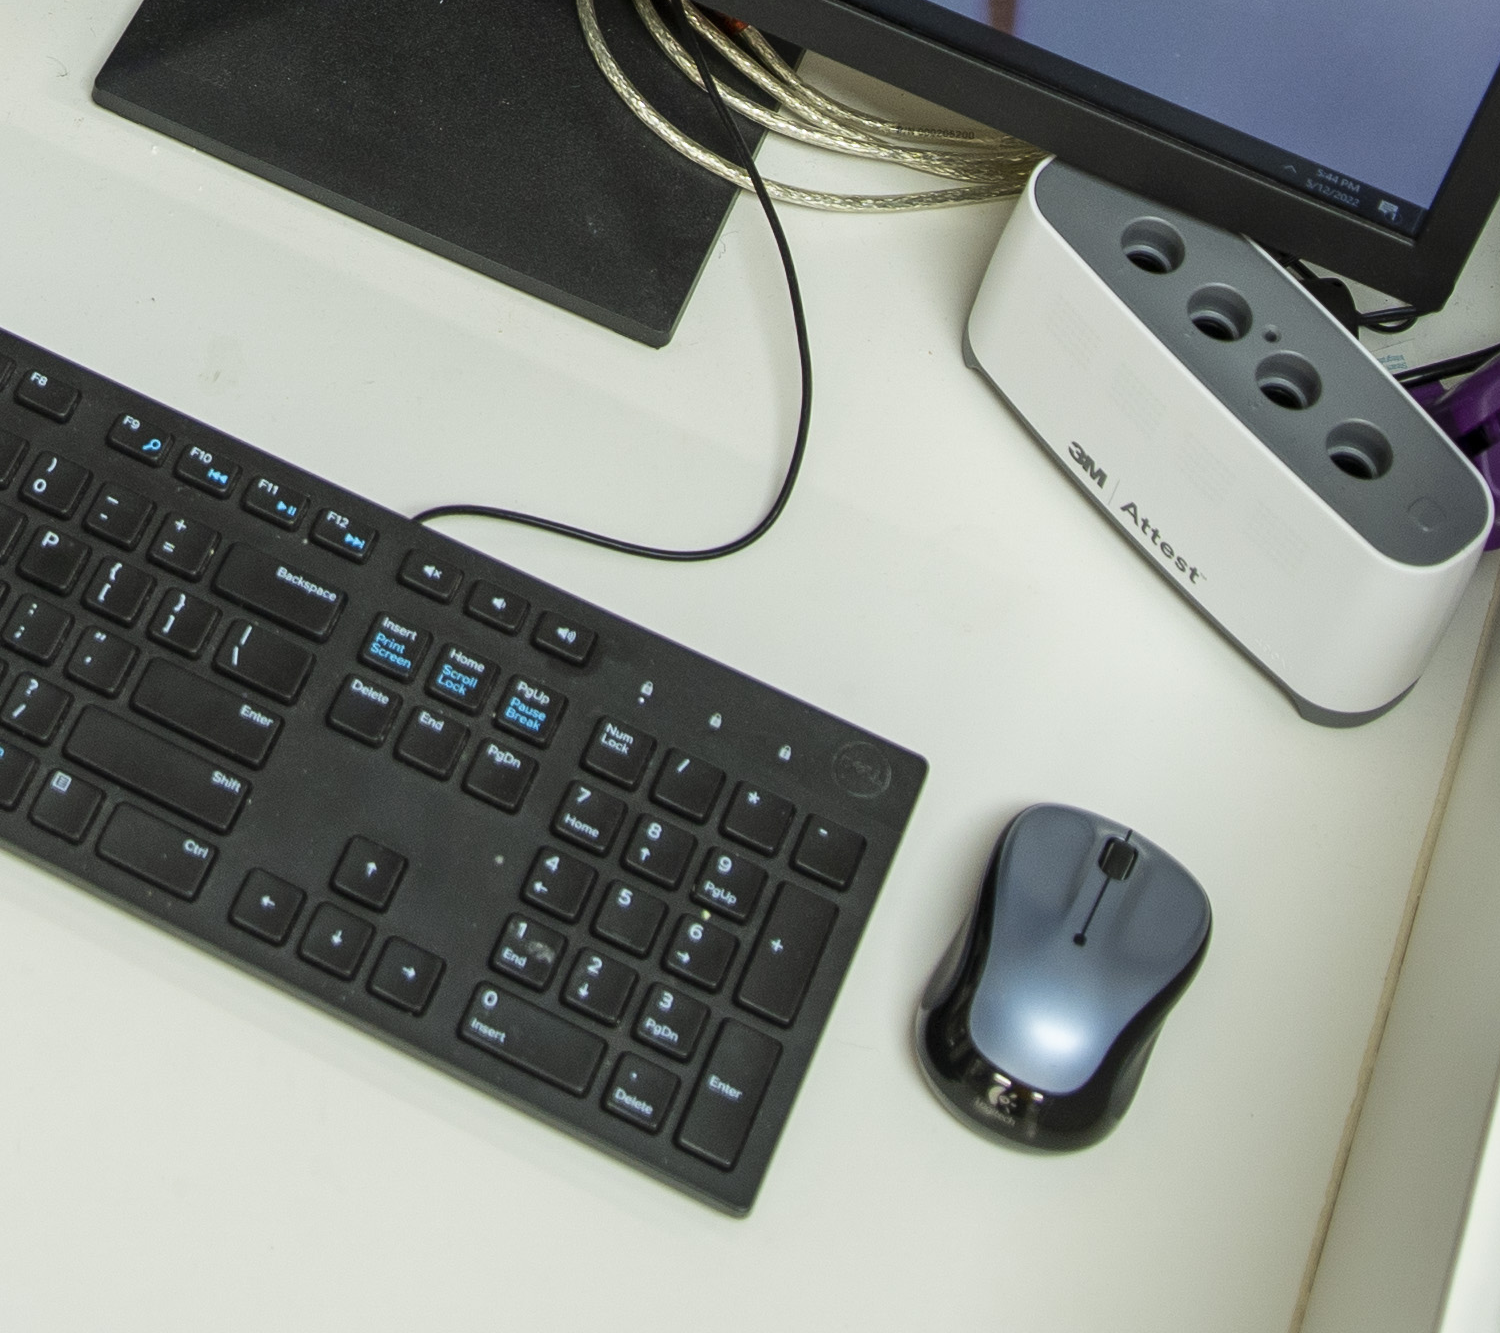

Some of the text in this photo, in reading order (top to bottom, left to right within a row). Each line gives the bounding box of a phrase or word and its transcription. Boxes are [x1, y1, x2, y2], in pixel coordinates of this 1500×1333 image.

[1341, 179, 1360, 192] PM
[31, 372, 48, 386] F8
[123, 415, 141, 430] F9
[190, 448, 212, 464] F10
[1068, 441, 1108, 491] 3M
[258, 479, 279, 495] F11
[327, 511, 349, 527] F12
[276, 566, 337, 602] Backspace
[383, 617, 417, 640] Insert
[370, 641, 412, 669] Screen
[375, 633, 405, 654] Print
[449, 649, 485, 672] Home
[438, 675, 467, 696] Lock
[442, 664, 478, 689] Scroll
[351, 679, 389, 704] Delete
[517, 681, 550, 705] PgUp
[240, 705, 274, 727] Enter
[420, 712, 444, 730] End
[505, 707, 541, 731] Break
[511, 698, 546, 722] Pause
[601, 733, 629, 754] Lock
[606, 723, 634, 743] Num
[487, 744, 521, 768] PgDn
[212, 771, 242, 791] Shift
[564, 814, 599, 838] Home
[184, 839, 208, 858] Ctrl
[705, 881, 737, 905] PgUp
[501, 948, 526, 967] End
[471, 1018, 506, 1043] Insert
[646, 1018, 679, 1042] PgDn
[709, 1076, 743, 1099] Enter
[614, 1088, 653, 1115] Delete
